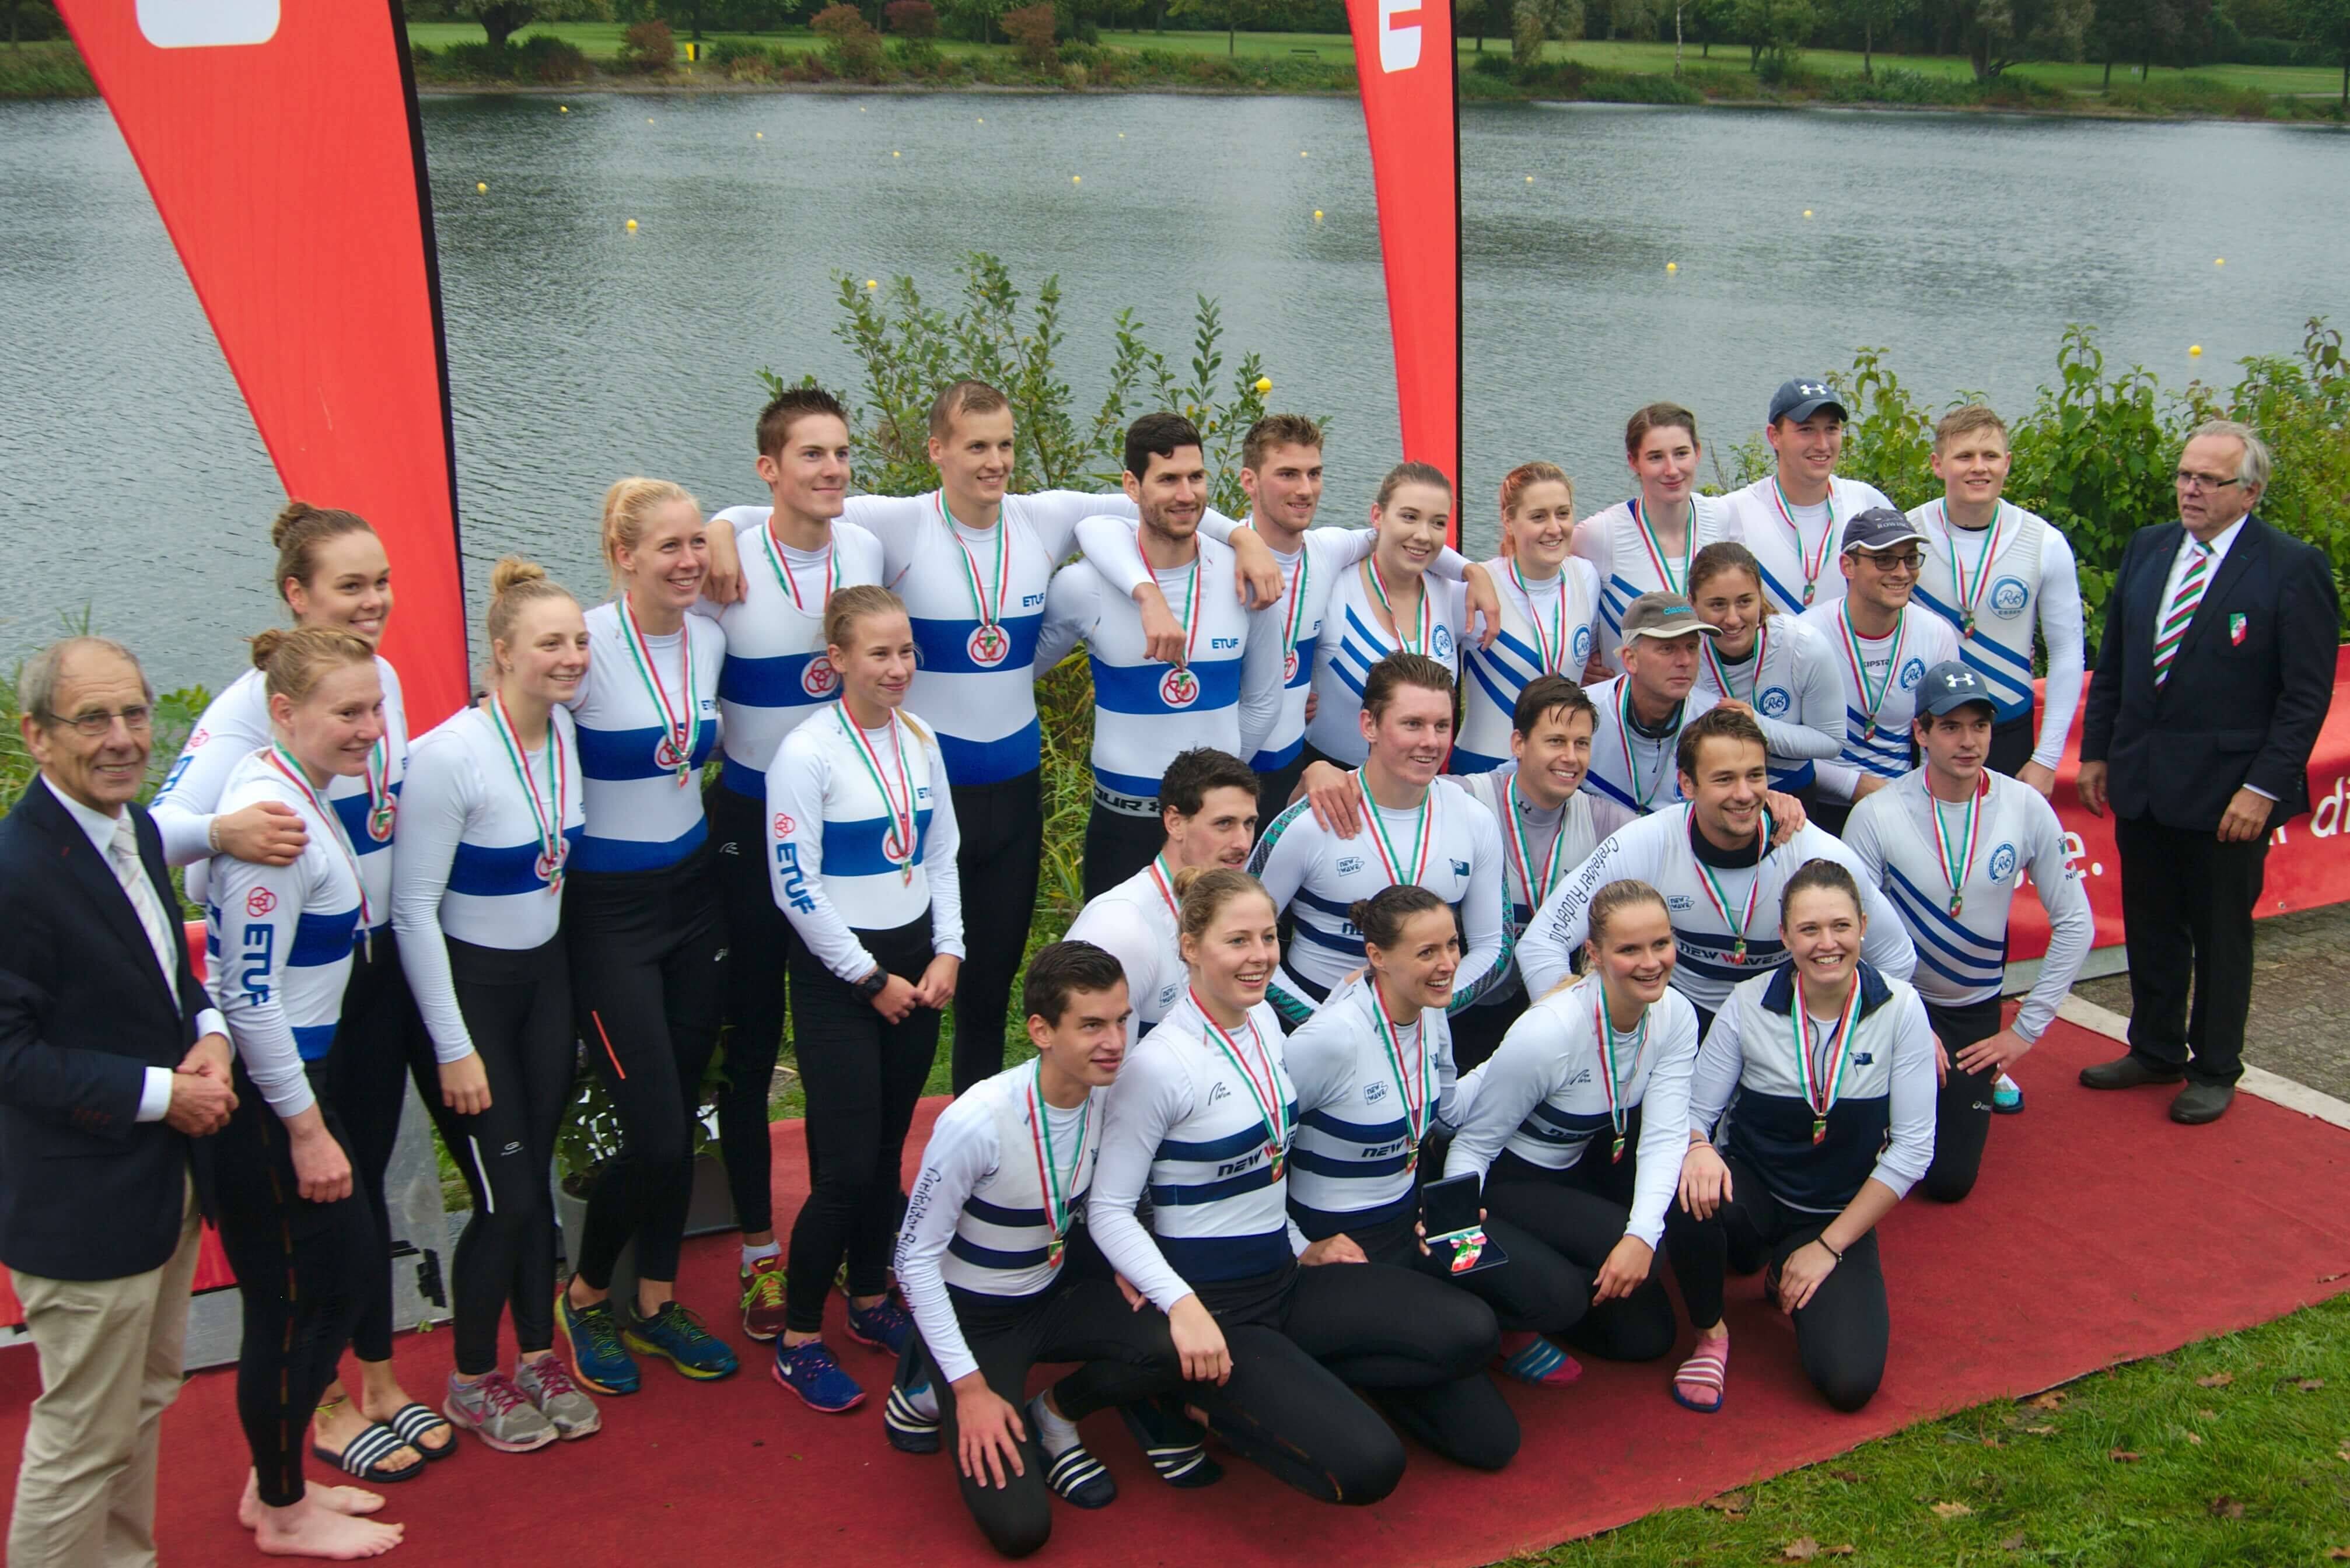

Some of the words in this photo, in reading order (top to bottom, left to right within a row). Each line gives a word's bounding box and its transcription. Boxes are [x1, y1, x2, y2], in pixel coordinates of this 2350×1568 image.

[1212, 638, 1239, 649] ETUF
[777, 843, 816, 915] ETUF
[1579, 836, 1619, 892] Crefelder
[239, 923, 274, 1006] ETUF
